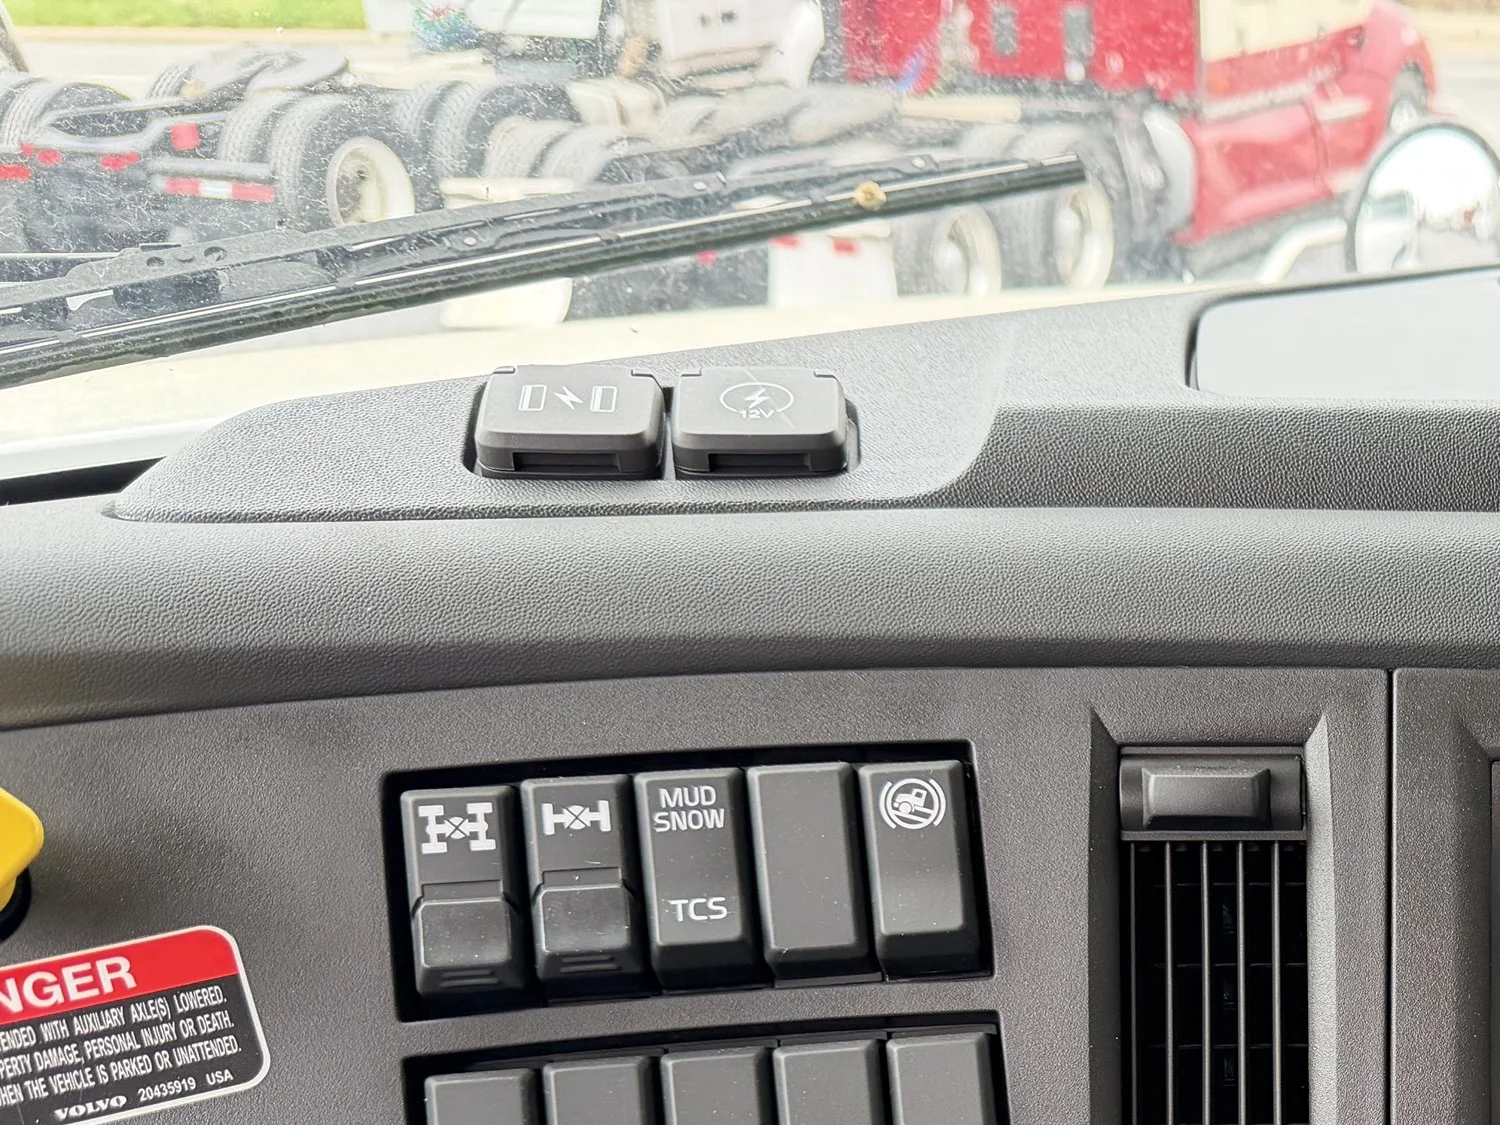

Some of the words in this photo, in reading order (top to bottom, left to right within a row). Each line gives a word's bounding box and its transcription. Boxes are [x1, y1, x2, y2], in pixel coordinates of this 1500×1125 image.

[739, 408, 774, 419] 12V
[660, 786, 717, 809] MUD
[653, 807, 726, 832] SNOW
[670, 897, 728, 922] TCS
[40, 1019, 70, 1042] WITH
[73, 1006, 125, 1036] AUXILIARY
[130, 997, 172, 1024] AXLE(S)
[173, 985, 227, 1013] LOWERED.
[33, 1043, 85, 1071] DAMAGE,
[84, 1031, 141, 1060] PERSONAL
[140, 1023, 179, 1048] INJURY
[179, 1015, 198, 1038] OR
[196, 1010, 235, 1034] DEATH.
[24, 1077, 49, 1100] THE
[49, 1067, 95, 1095] VEHICLE
[96, 1063, 109, 1085] IS
[110, 1054, 153, 1082] PARKED
[154, 1047, 173, 1072] OR
[173, 1035, 242, 1066] UNATTENDED.
[54, 1095, 128, 1121] VOLVO
[137, 1077, 197, 1103] 20435919
[206, 1069, 234, 1086] USA
